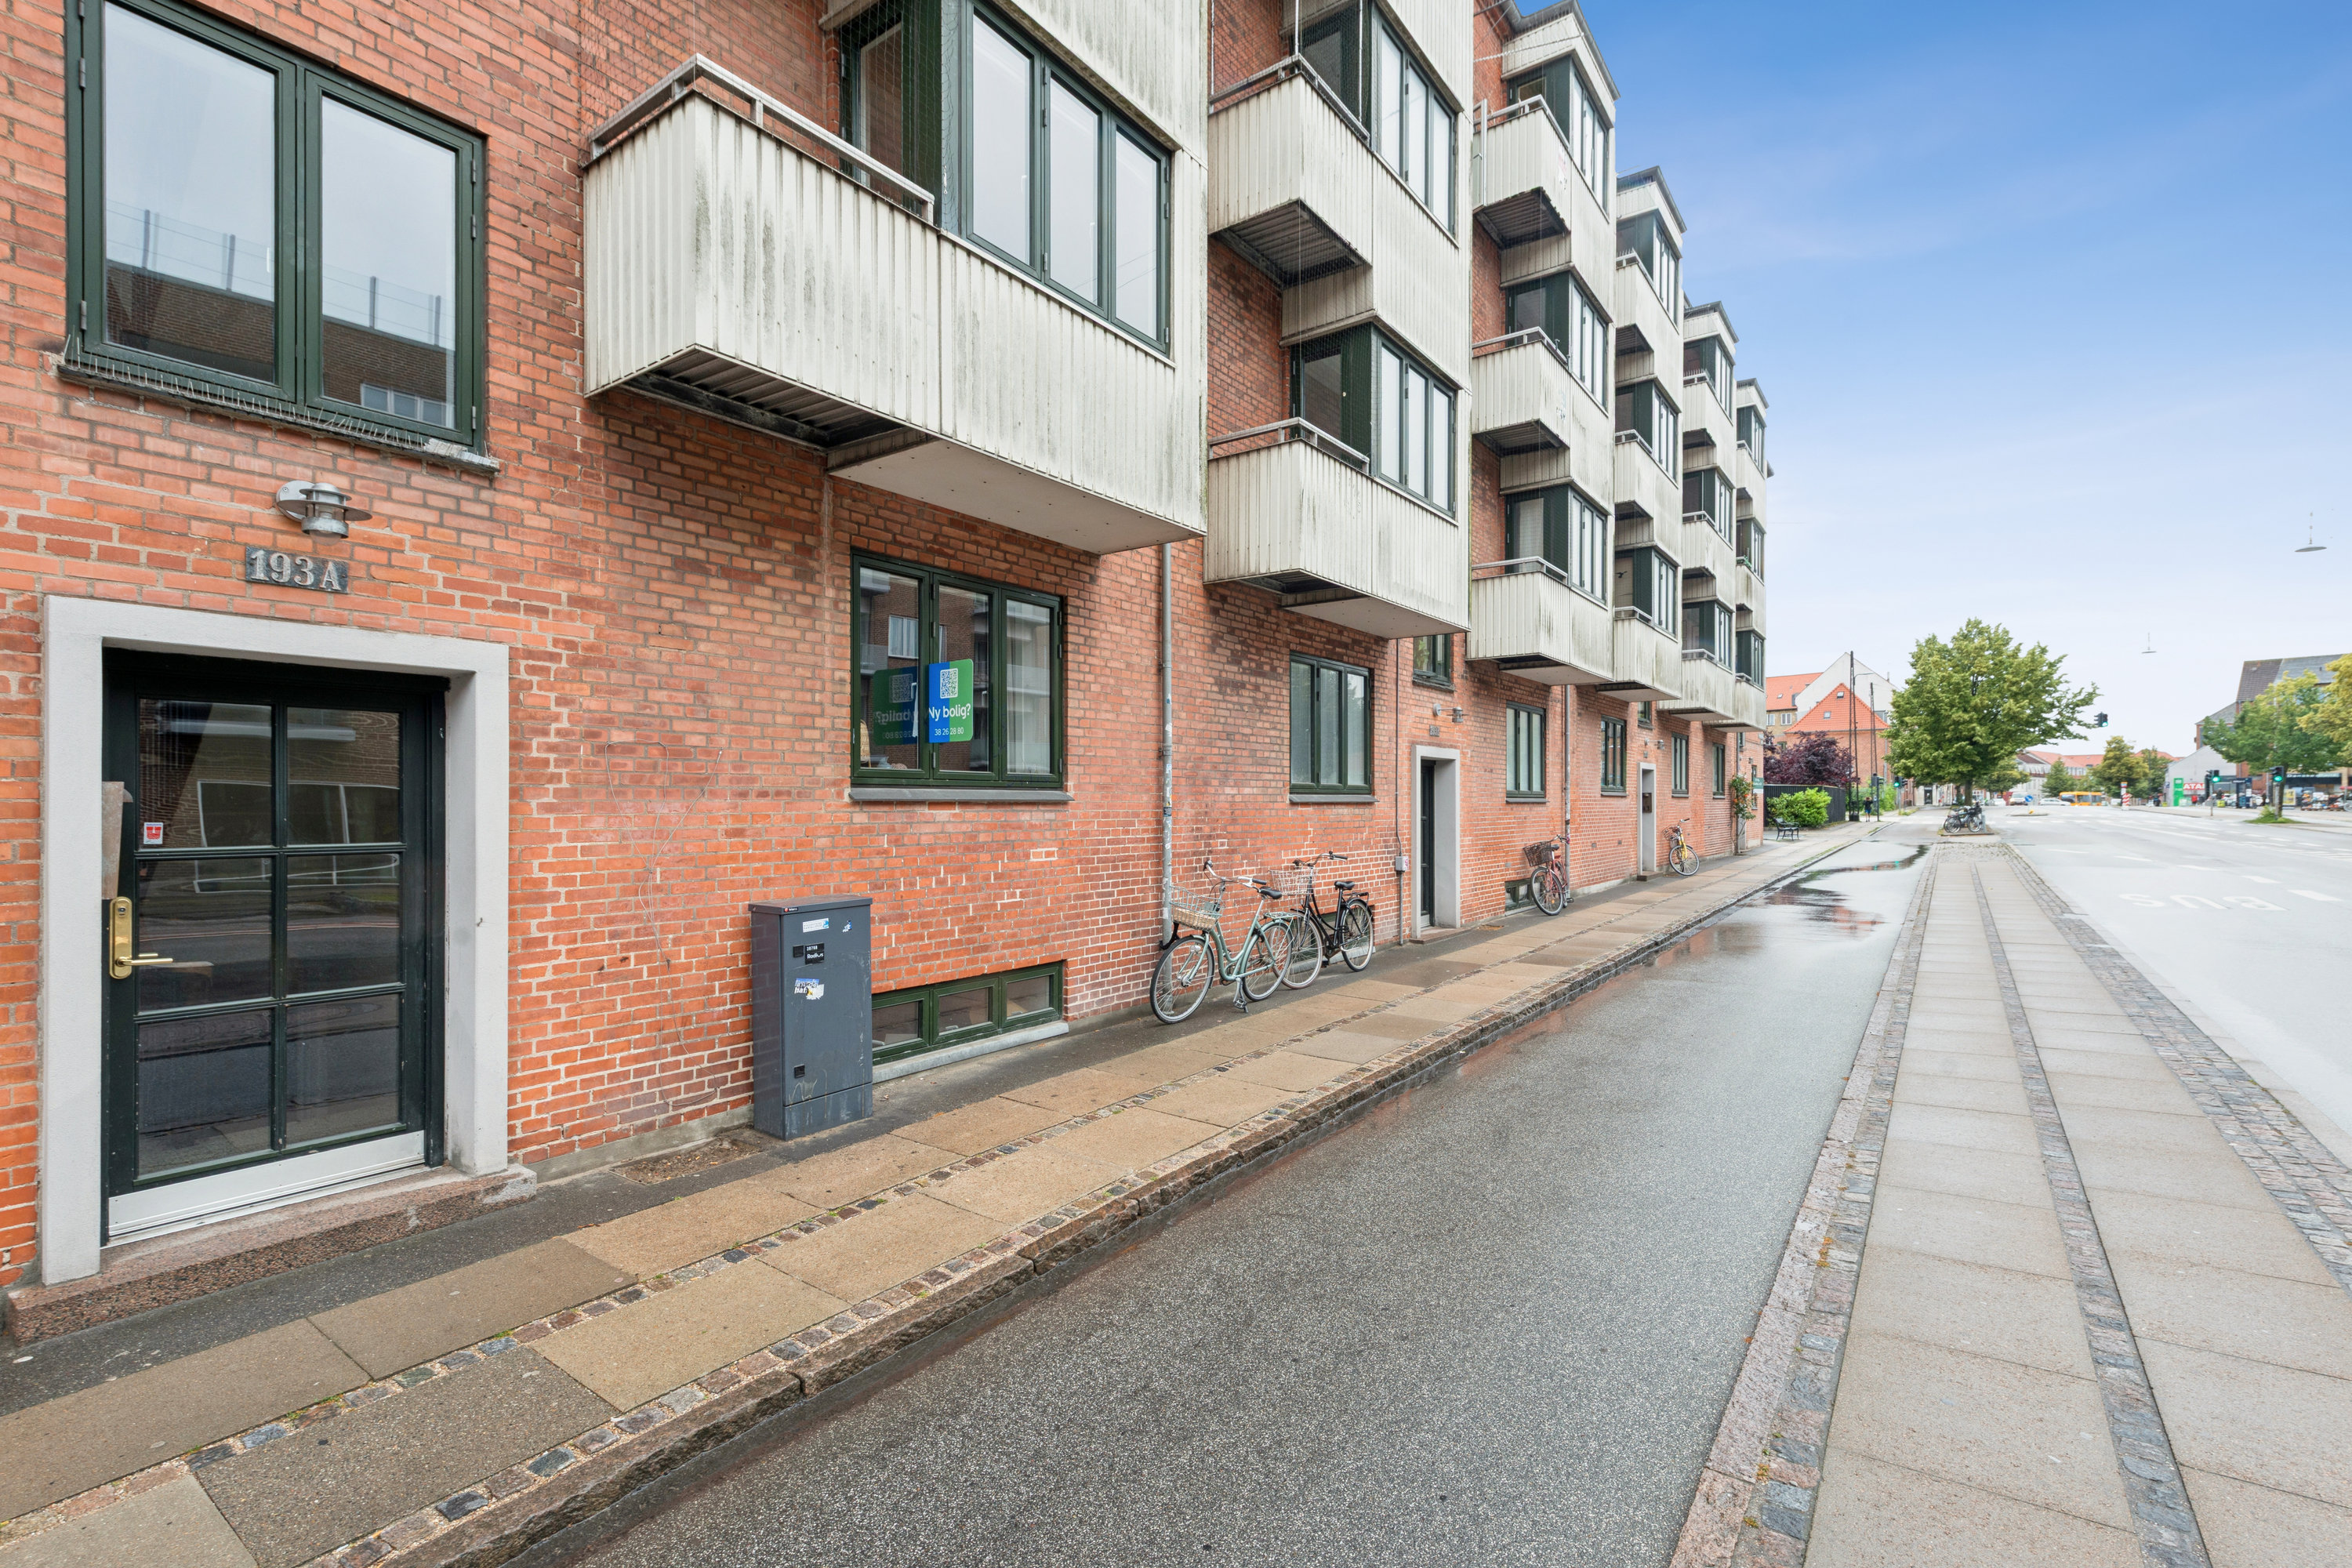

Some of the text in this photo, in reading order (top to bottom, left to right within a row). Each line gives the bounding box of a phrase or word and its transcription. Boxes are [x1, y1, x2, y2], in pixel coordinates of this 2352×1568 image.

[250, 550, 342, 590] 193A
[929, 703, 971, 721] Ny bolig?
[2118, 893, 2288, 911] BUS
